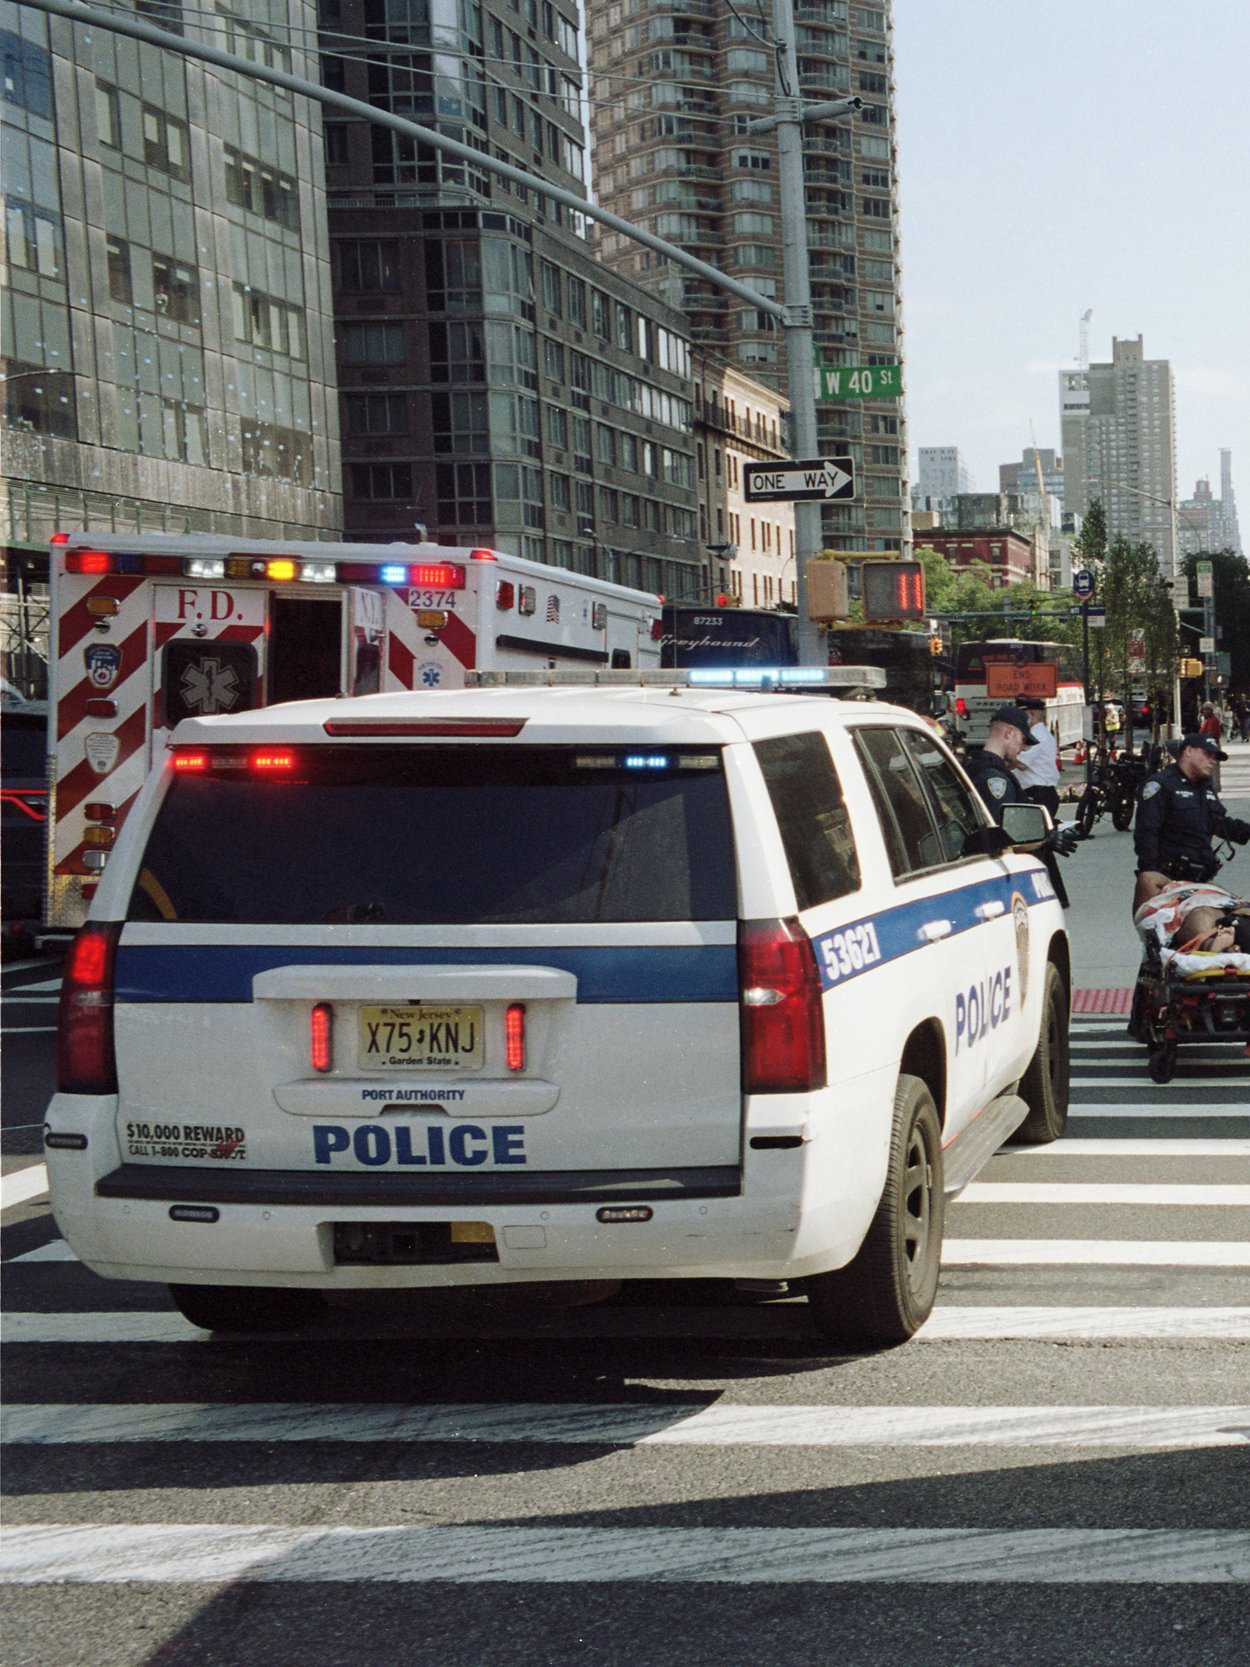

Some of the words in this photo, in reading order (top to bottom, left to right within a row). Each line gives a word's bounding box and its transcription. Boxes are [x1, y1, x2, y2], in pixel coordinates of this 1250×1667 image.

[825, 371, 841, 395] W
[848, 370, 873, 394] 40
[880, 370, 893, 385] St
[753, 473, 786, 491] ONE
[803, 471, 839, 488] WAY
[177, 589, 244, 621] F.D.
[410, 590, 456, 608] 2374
[660, 634, 761, 651] Greyhound
[1014, 670, 1031, 680] END
[996, 682, 1020, 692] ROAD
[1024, 682, 1048, 691] WORK
[820, 921, 882, 981] 53621
[390, 1008, 415, 1020] New
[419, 1009, 452, 1021] Jersey
[955, 965, 1012, 1057] POLICE
[367, 1022, 412, 1054] X75
[429, 1022, 475, 1054] KNJ
[389, 1056, 423, 1065] Garden
[426, 1056, 452, 1065] State
[362, 1089, 394, 1101] PORT
[395, 1089, 465, 1101] AUTHORITY
[126, 1122, 180, 1141] $10,000
[183, 1125, 245, 1144] REWARD
[128, 1145, 150, 1156] CALL
[152, 1146, 179, 1158] 1-800
[313, 1124, 527, 1166] POLICE
